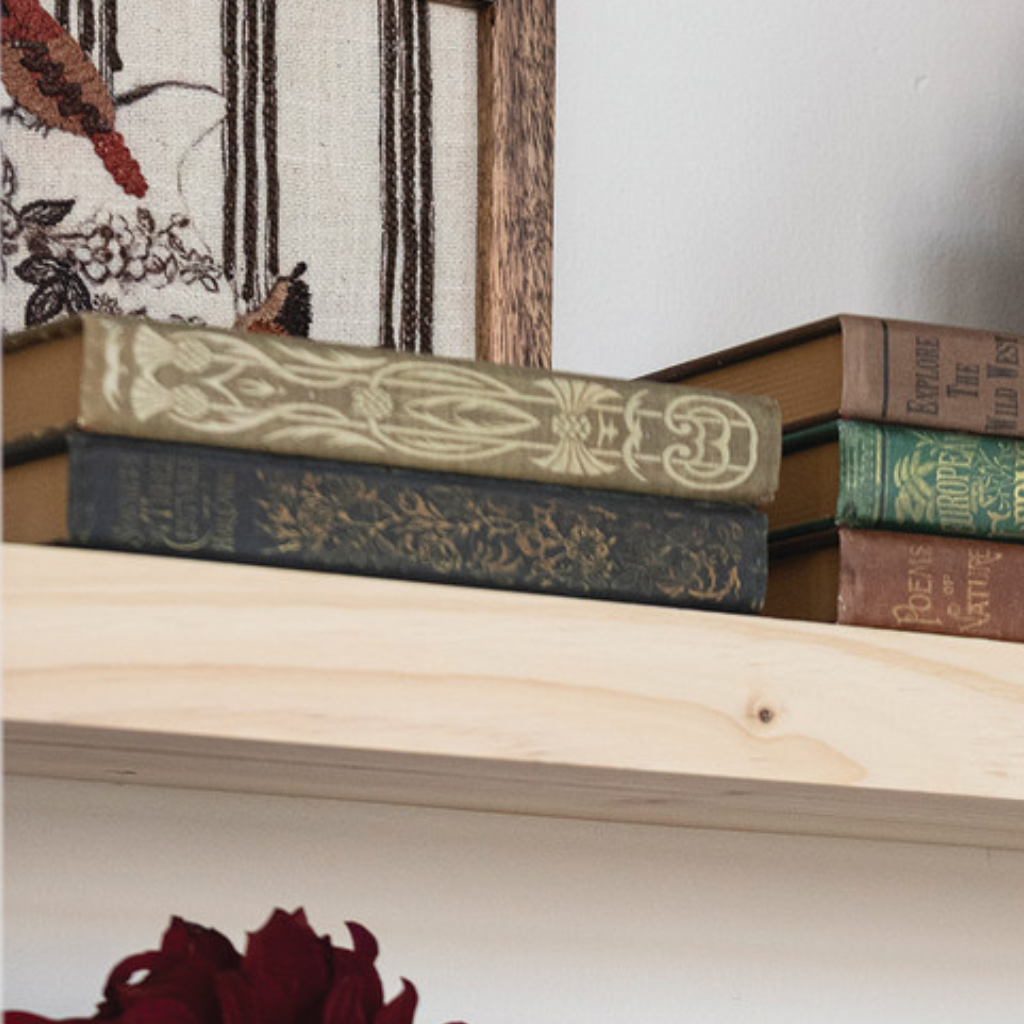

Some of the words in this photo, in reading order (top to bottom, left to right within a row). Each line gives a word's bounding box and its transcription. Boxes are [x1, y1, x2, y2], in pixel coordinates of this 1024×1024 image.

[906, 337, 940, 416] EXPLORE
[985, 335, 1019, 379] WEST
[946, 363, 980, 399] THE
[985, 387, 1019, 433] WILD
[891, 545, 943, 626] POEMS
[943, 573, 954, 595] OF
[947, 547, 1003, 633] NATURE
